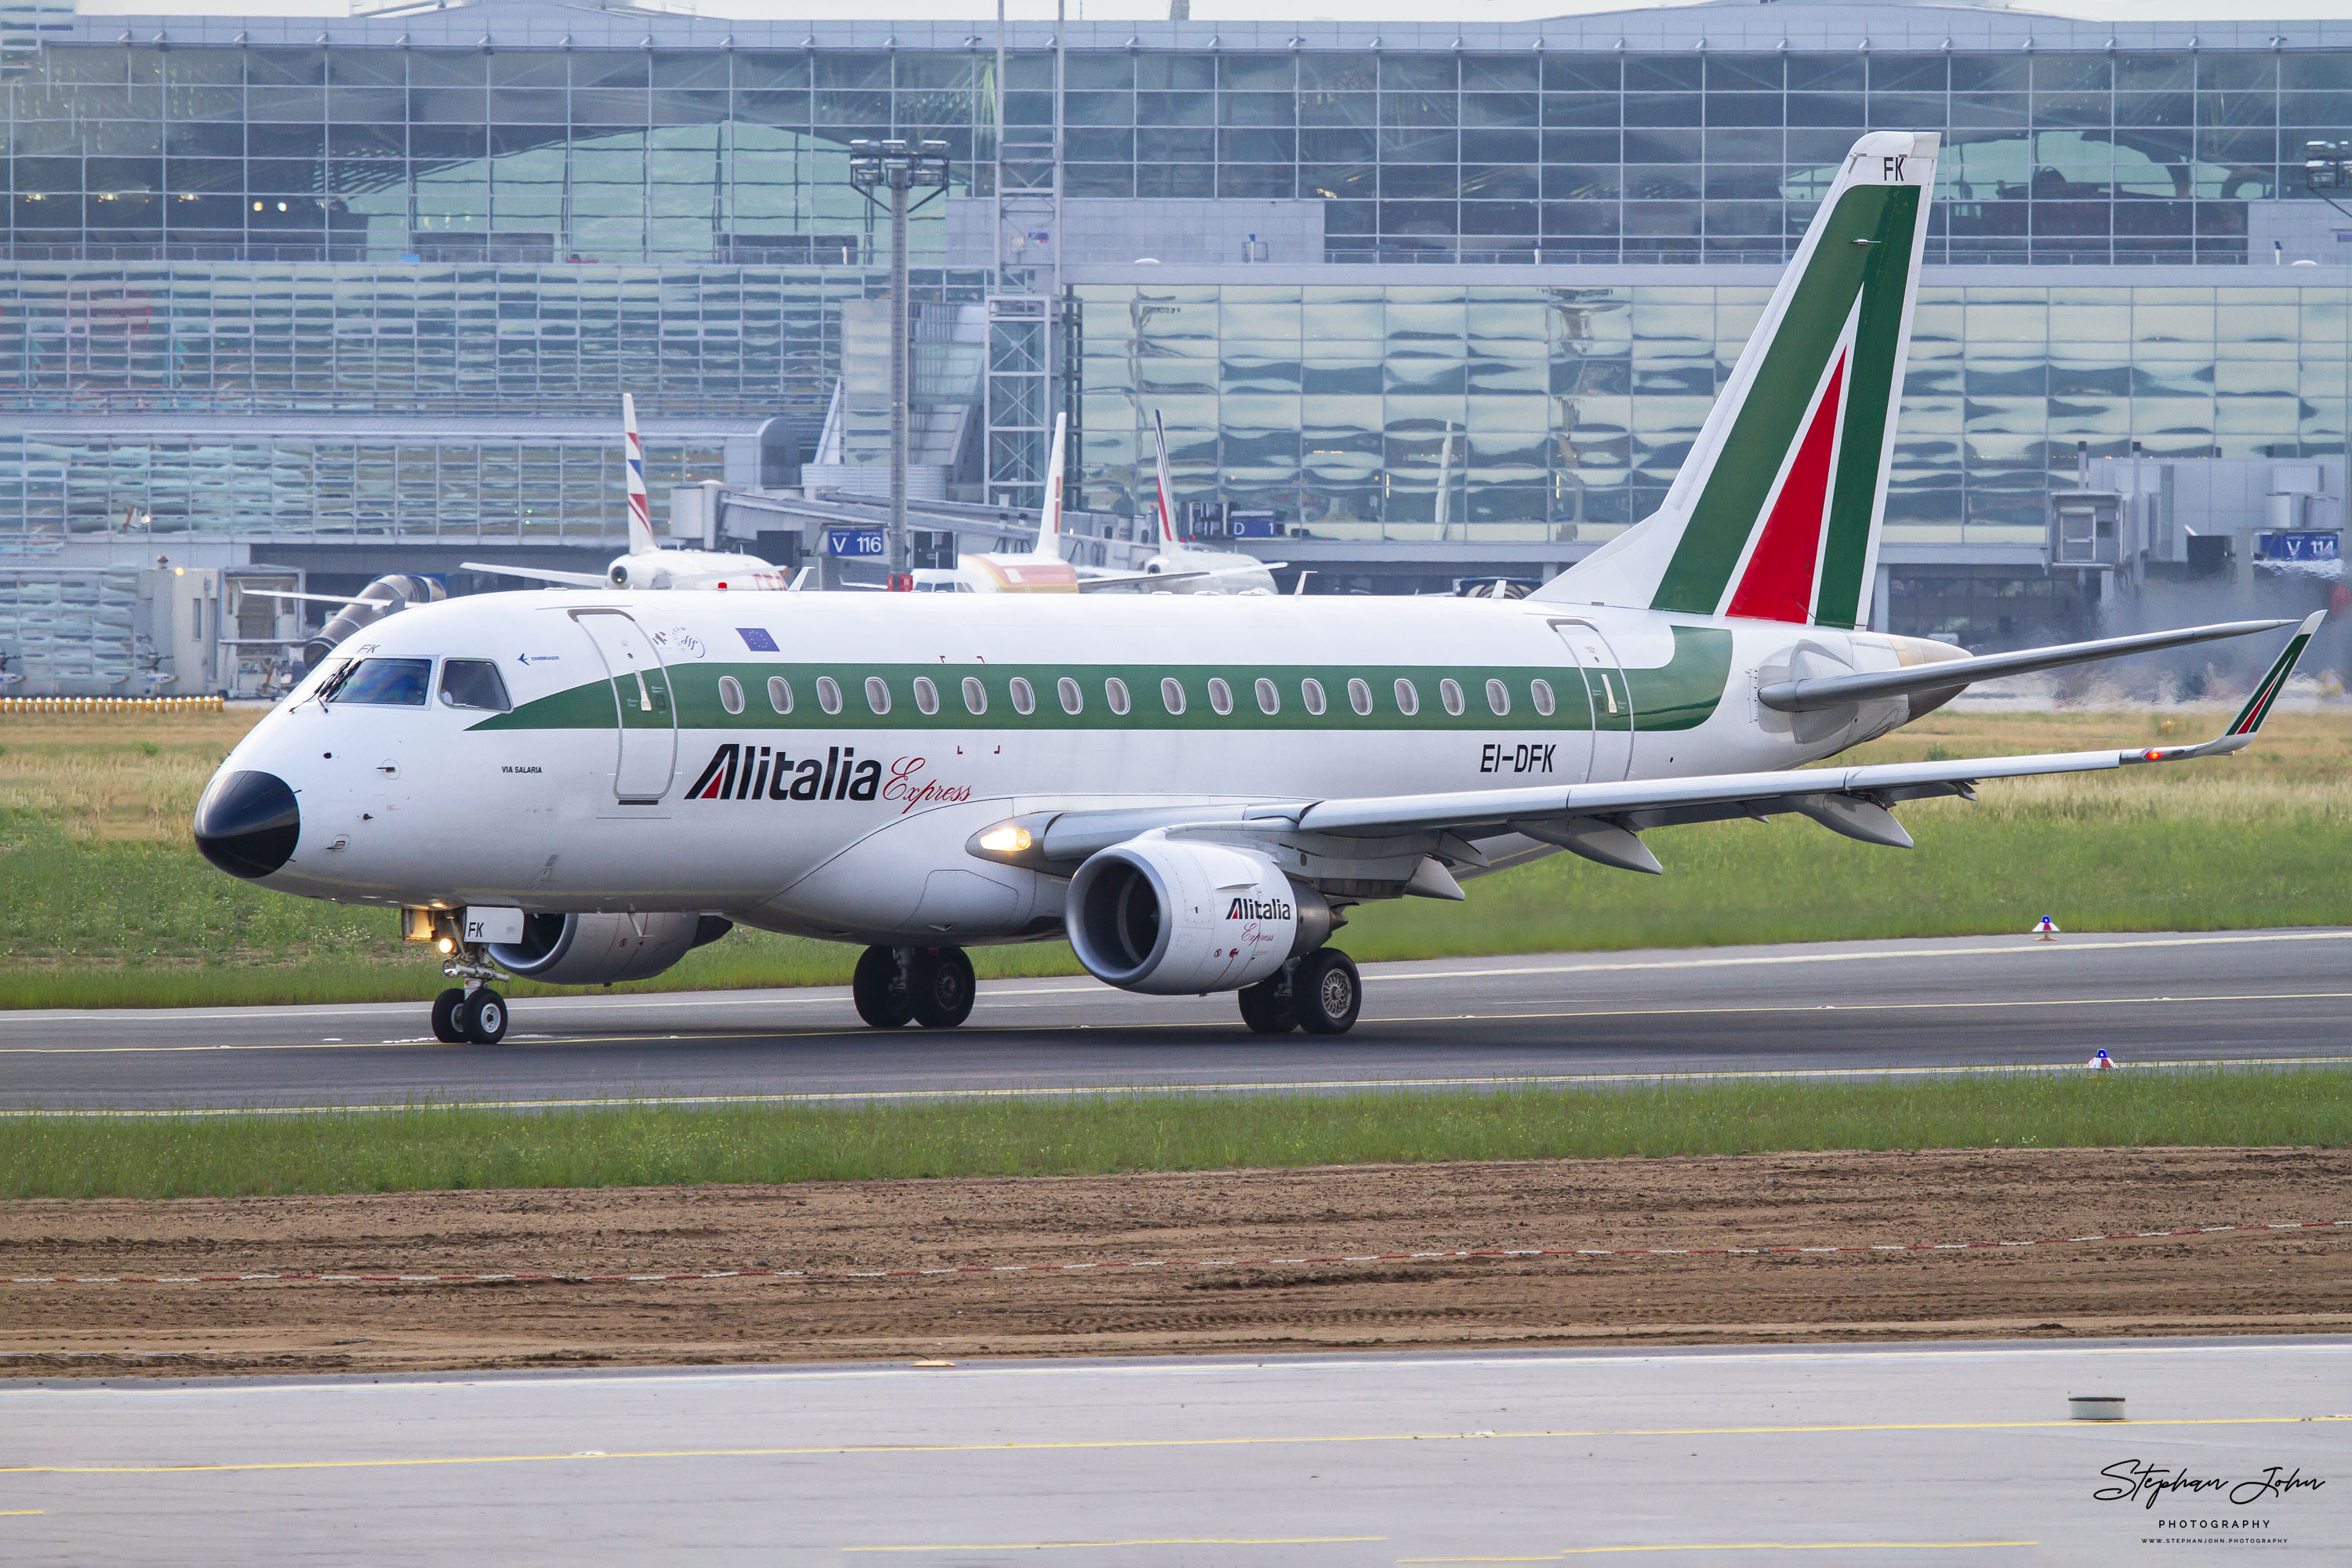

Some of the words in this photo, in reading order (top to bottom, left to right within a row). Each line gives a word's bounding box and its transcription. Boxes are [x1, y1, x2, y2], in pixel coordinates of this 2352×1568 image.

[1883, 157, 1904, 182] FK
[1233, 522, 1245, 535] D
[832, 537, 847, 553] V
[856, 536, 882, 553] 116
[2286, 540, 2301, 556] V
[357, 644, 380, 653] FK
[1480, 744, 1557, 773] EI-DFK
[684, 743, 882, 800] Alitalia
[882, 756, 972, 814] Express
[1225, 898, 1290, 920] Alitalia
[467, 922, 485, 938] FK
[1241, 923, 1274, 946] Express
